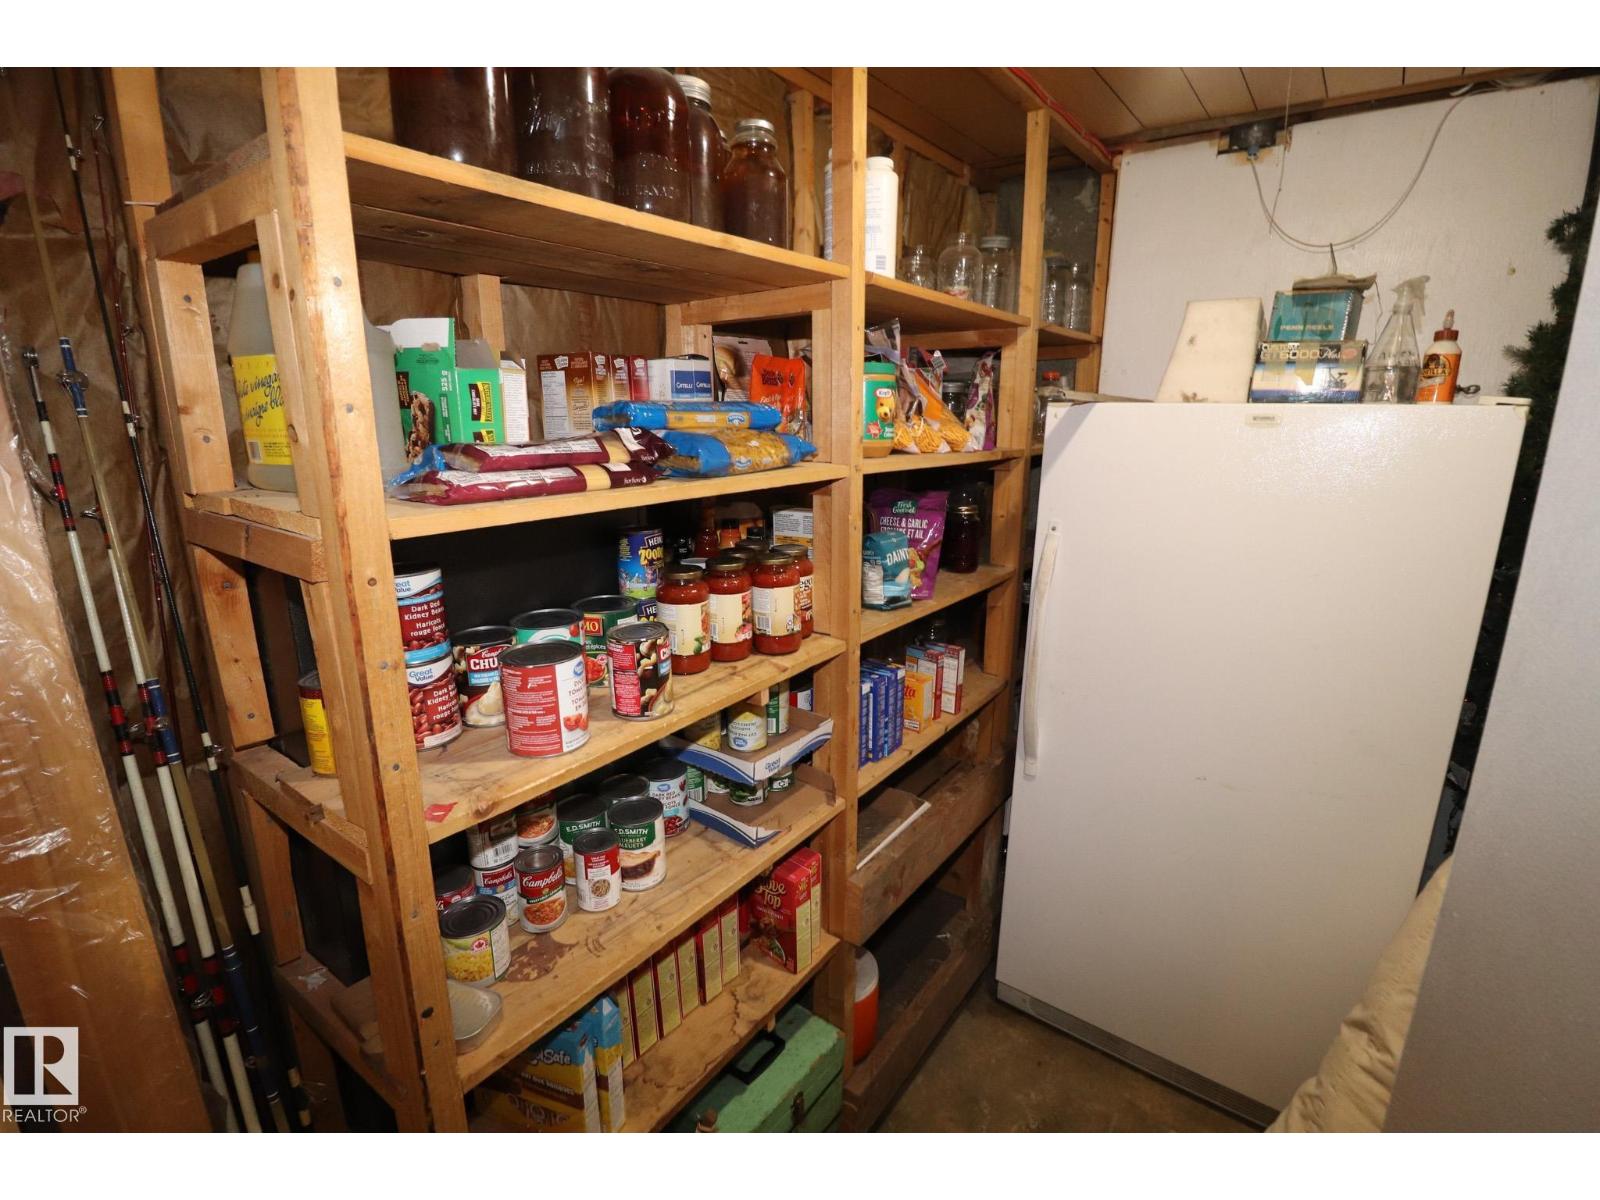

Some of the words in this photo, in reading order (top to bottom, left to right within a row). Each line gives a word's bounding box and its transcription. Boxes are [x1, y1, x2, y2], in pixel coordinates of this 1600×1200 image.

[880, 516, 900, 527] CHEESE
[901, 518, 906, 527] &
[907, 518, 928, 528] GARLIC
[648, 536, 663, 547] HEIN
[395, 580, 411, 588] eat
[411, 604, 428, 613] Dark
[404, 611, 429, 621] Kidney
[470, 658, 498, 671] CHU
[409, 668, 432, 678] Great
[415, 674, 433, 682] Value
[763, 890, 781, 909] Top
